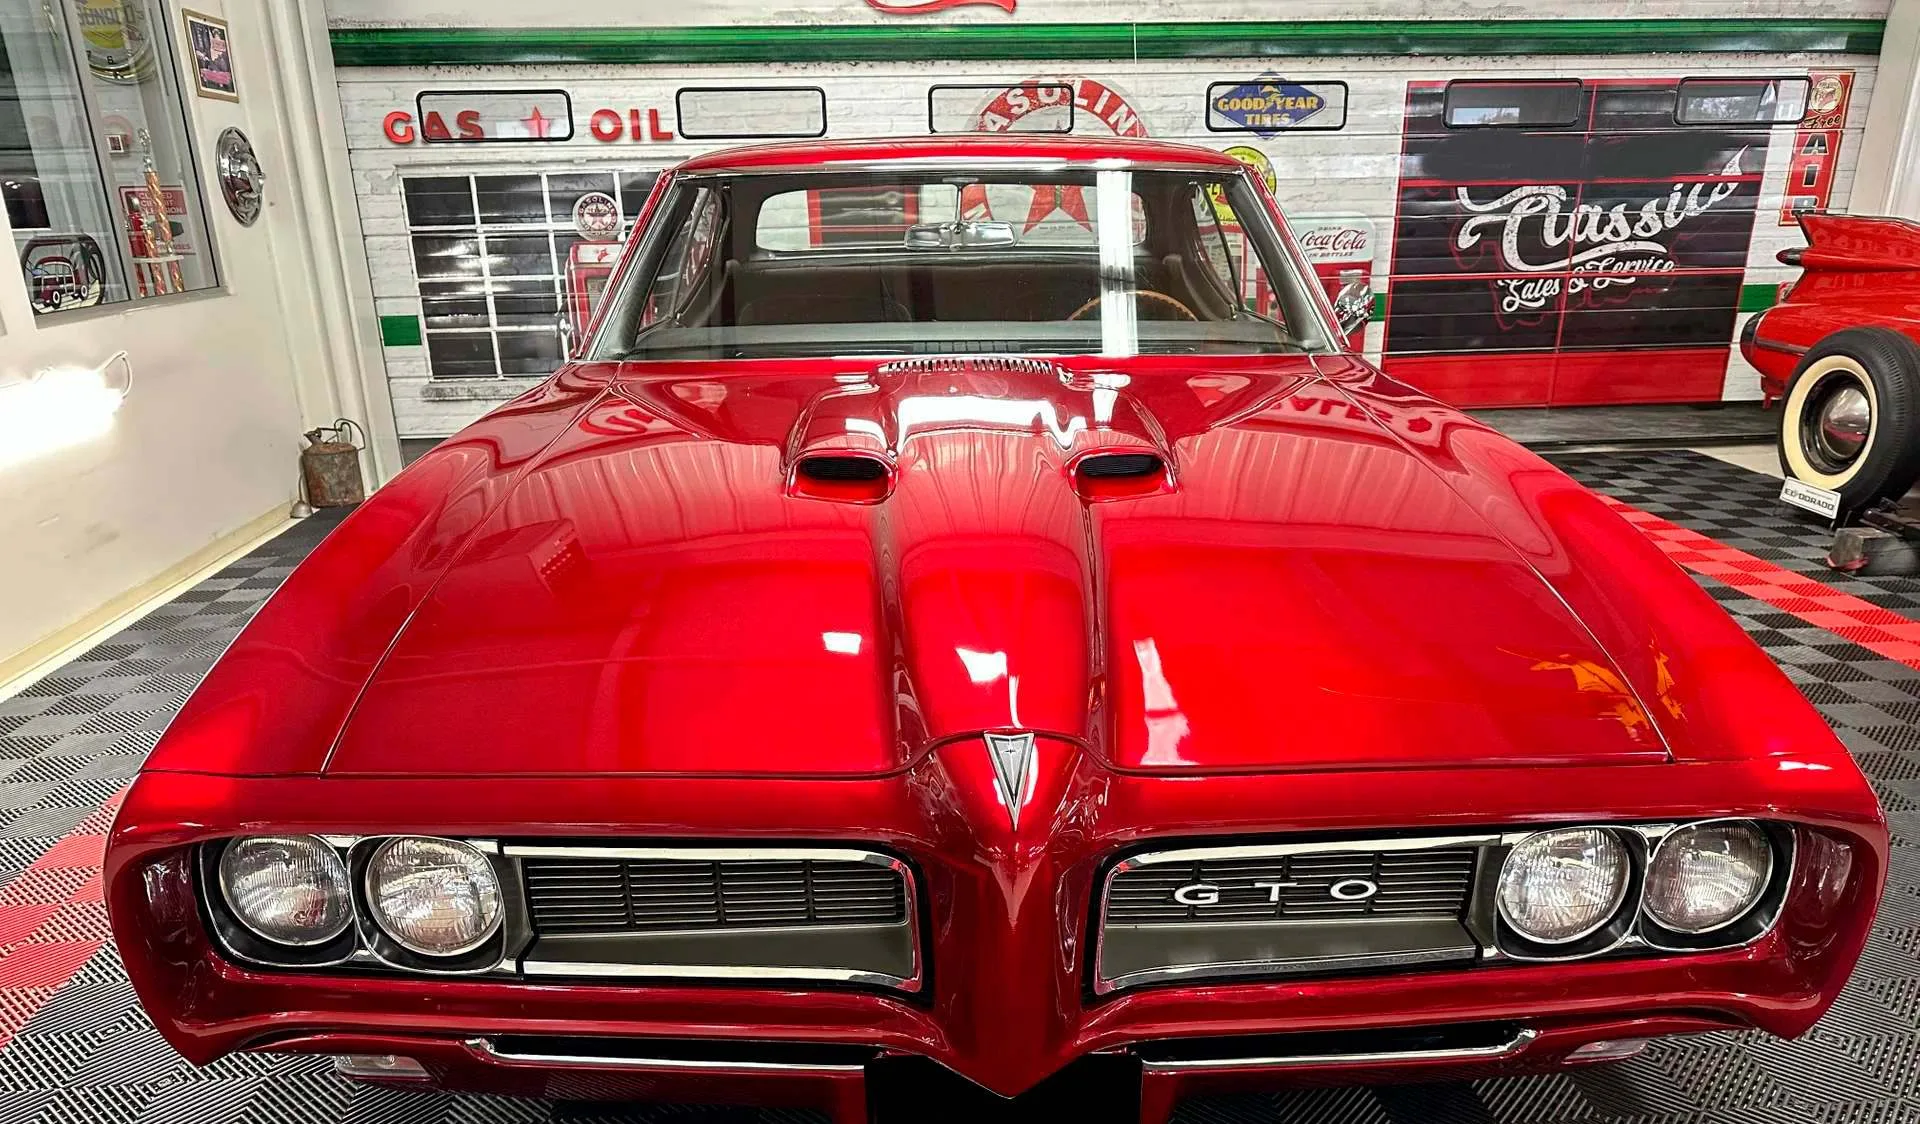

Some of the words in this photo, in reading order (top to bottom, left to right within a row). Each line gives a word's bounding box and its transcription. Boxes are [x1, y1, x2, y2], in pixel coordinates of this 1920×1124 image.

[983, 78, 1139, 137] ASOLIN
[1244, 113, 1291, 127] TIRES
[1803, 114, 1842, 129] Free
[383, 110, 485, 144] GAS
[590, 108, 674, 142] OIL
[1497, 278, 1560, 312] Sales
[1585, 256, 1675, 289] Service
[1174, 878, 1377, 905] GTO
